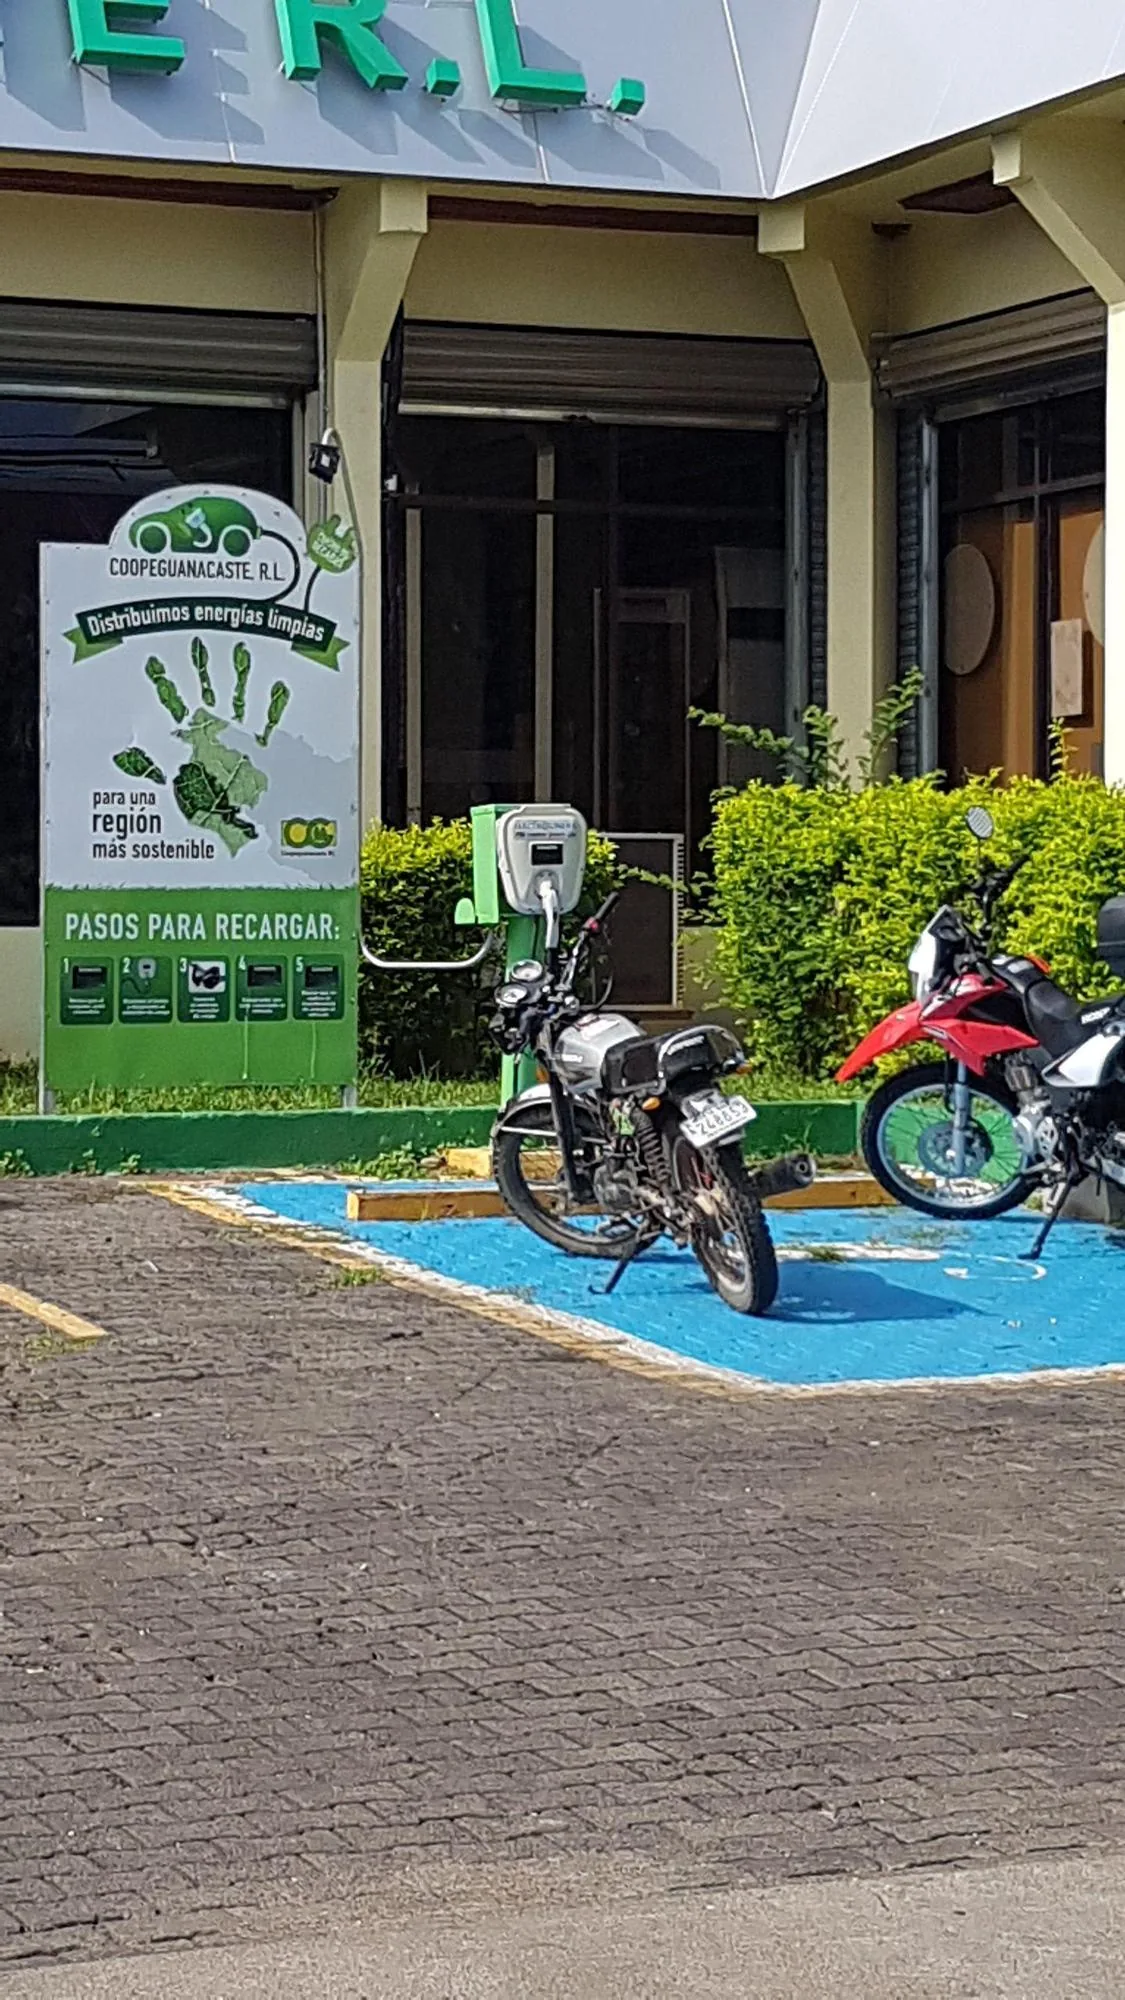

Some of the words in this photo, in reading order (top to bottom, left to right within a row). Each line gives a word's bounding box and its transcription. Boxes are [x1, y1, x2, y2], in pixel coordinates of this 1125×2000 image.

[86, 604, 190, 636] Distribuimos
[194, 603, 264, 628] energías
[267, 608, 325, 642] limpias
[92, 792, 125, 809] para
[130, 792, 156, 805] una
[92, 807, 162, 840] región
[92, 838, 126, 859] más
[132, 839, 215, 860] sostenible
[65, 912, 139, 940] PASOS
[148, 913, 206, 940] PARA
[216, 913, 340, 940] RECARGAR:
[63, 957, 70, 974] 1
[122, 957, 131, 973] 2
[179, 957, 188, 973] 3
[238, 956, 247, 971] 4
[295, 956, 304, 972] 5
